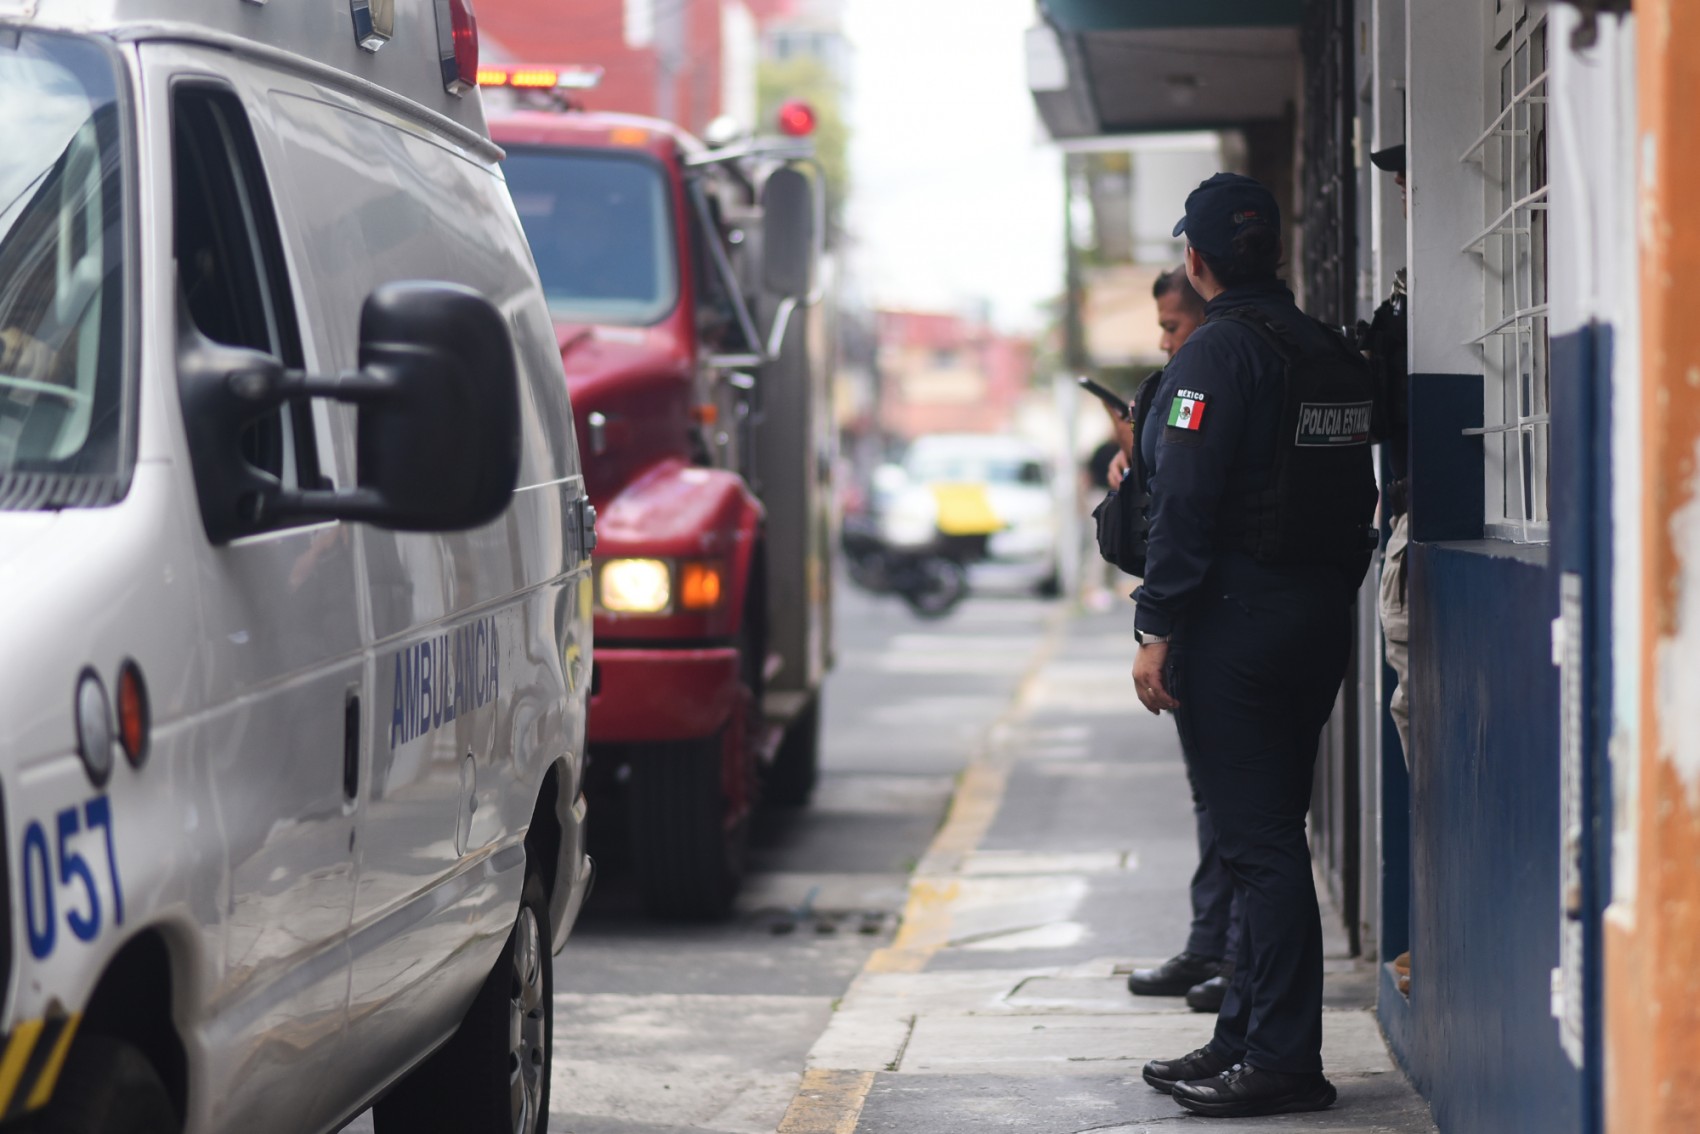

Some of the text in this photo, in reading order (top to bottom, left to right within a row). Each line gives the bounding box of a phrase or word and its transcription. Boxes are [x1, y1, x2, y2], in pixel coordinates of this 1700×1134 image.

[1301, 408, 1341, 435] POLICIA
[391, 615, 499, 750] AMBULANCIA
[22, 793, 125, 961] 057
